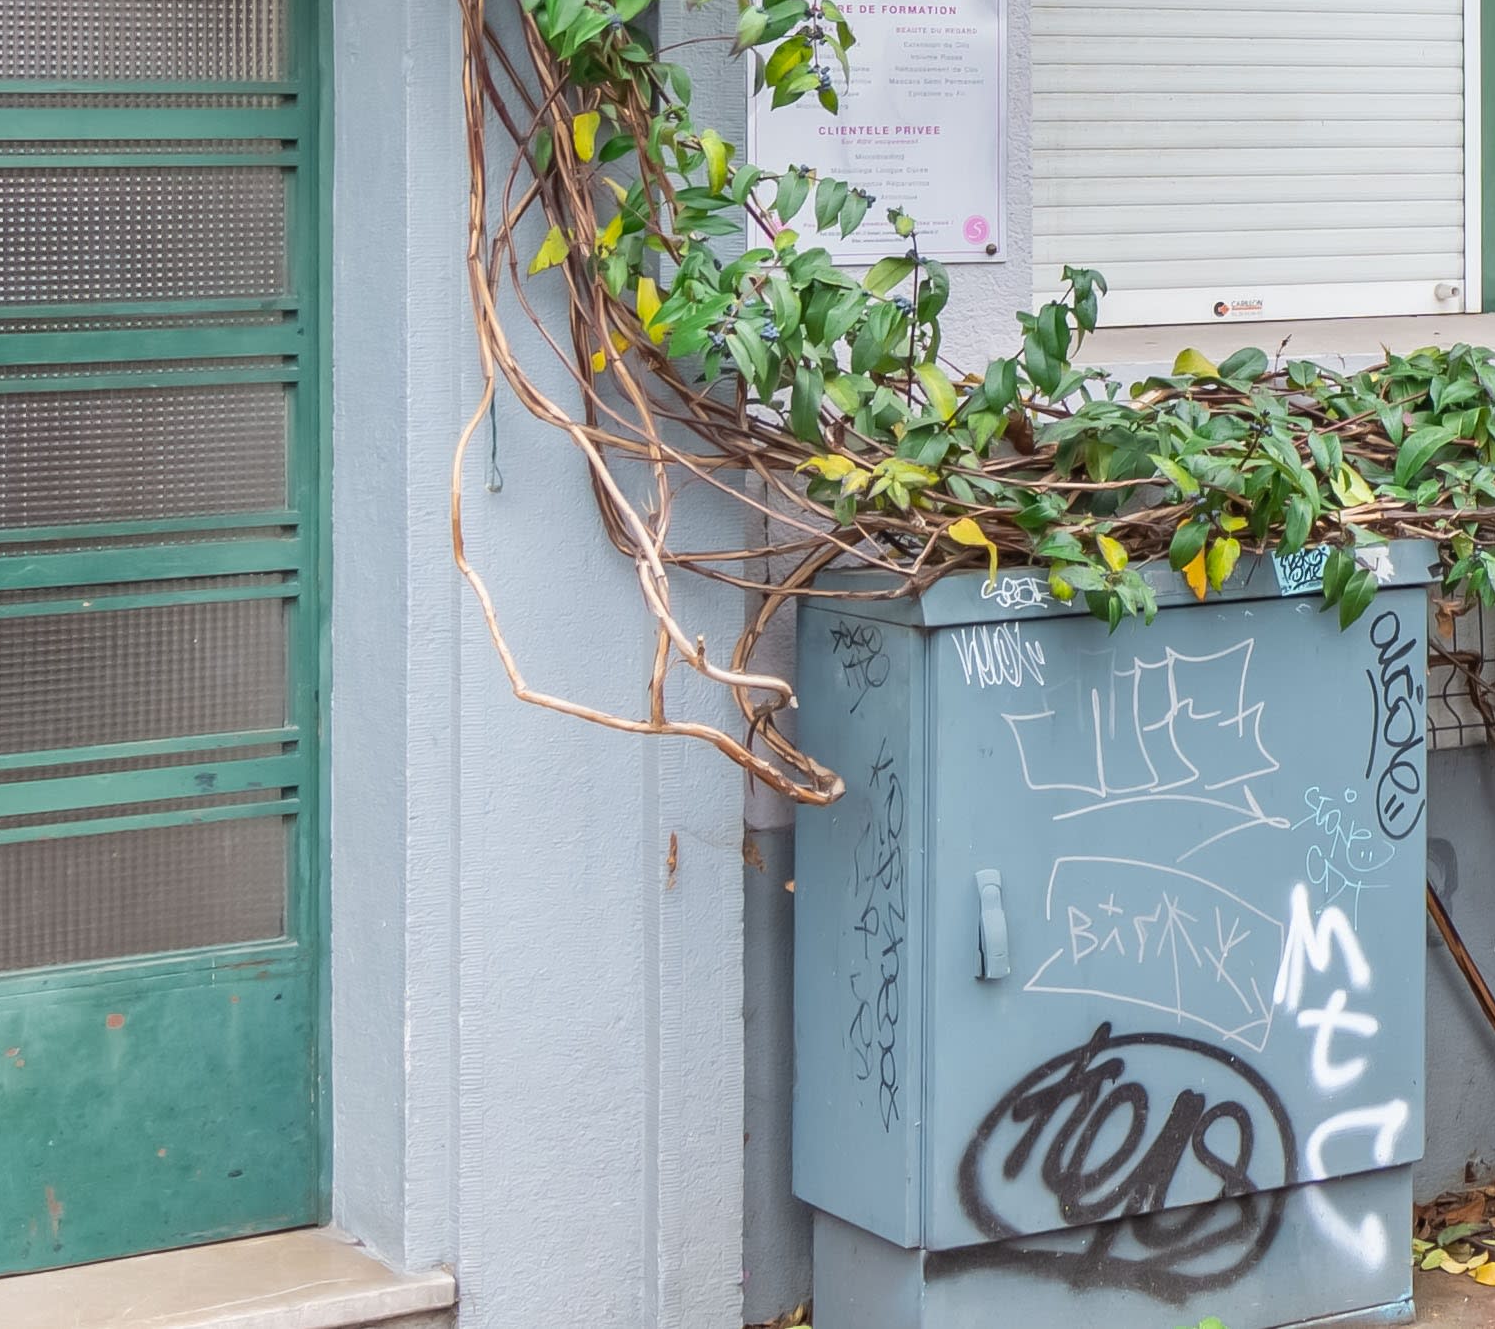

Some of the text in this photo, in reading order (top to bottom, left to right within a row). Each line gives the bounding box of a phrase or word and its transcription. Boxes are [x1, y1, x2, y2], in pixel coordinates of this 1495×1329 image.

[859, 5, 875, 15] DE
[882, 5, 957, 16] FORMATION
[818, 126, 941, 135] CLIENTELE PRIVEE
